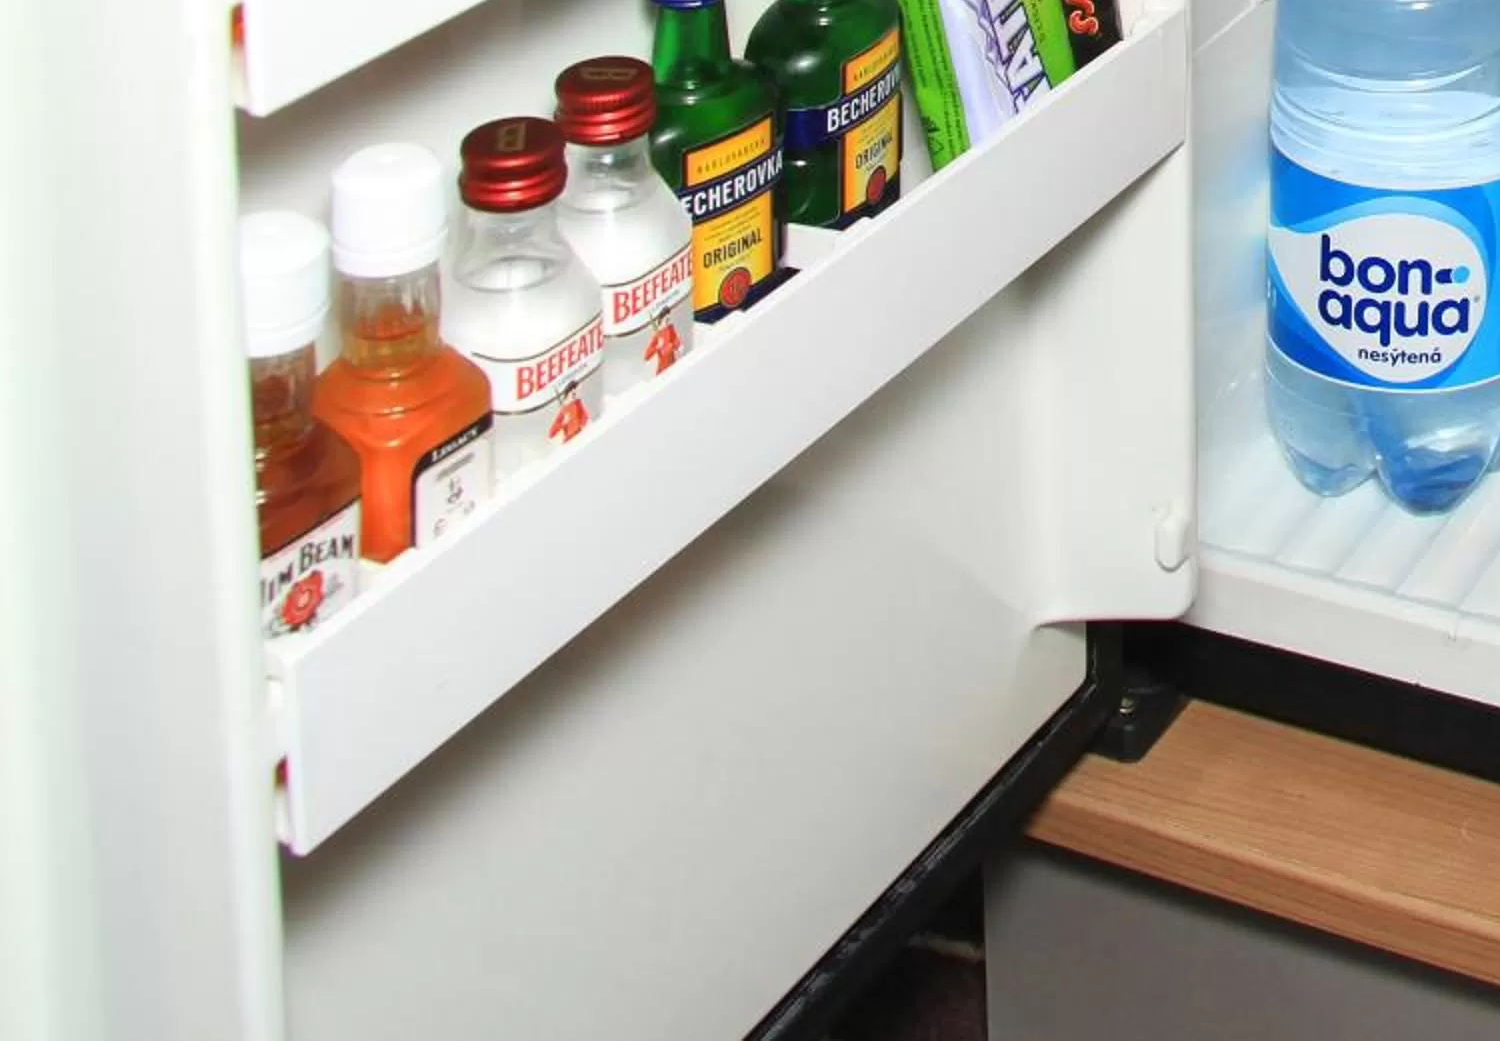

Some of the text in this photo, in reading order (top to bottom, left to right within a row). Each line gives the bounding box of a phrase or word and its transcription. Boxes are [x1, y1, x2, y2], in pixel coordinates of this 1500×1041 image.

[681, 149, 783, 216] ECHEROVKA
[702, 226, 764, 269] ORIGINAL
[1318, 289, 1470, 347] aqua
[1357, 347, 1443, 367] nesýtená
[300, 533, 355, 573] BEAM
